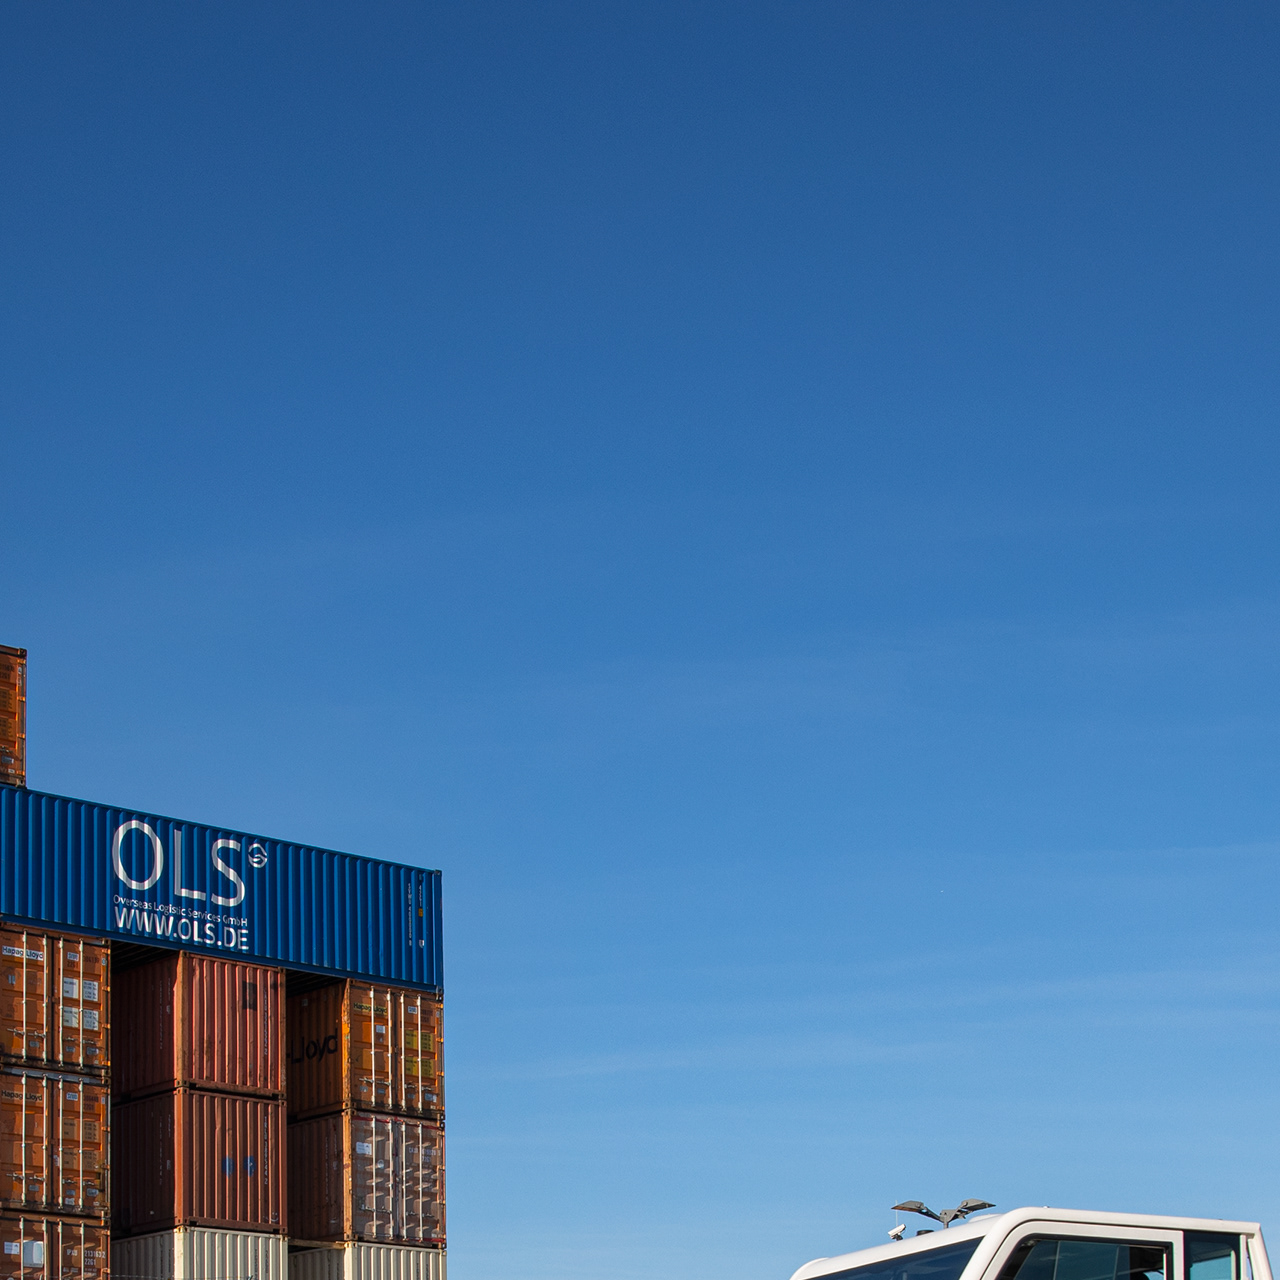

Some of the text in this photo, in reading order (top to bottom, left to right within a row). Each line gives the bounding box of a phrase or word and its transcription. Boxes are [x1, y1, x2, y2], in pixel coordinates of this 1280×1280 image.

[112, 820, 246, 908] OLS
[113, 894, 248, 927] Overseas Logistic Services GmbH
[114, 906, 249, 950] WWW.OLS.DE
[2, 946, 44, 960] HapagLloyd
[1, 1090, 43, 1101] HapagLloyd
